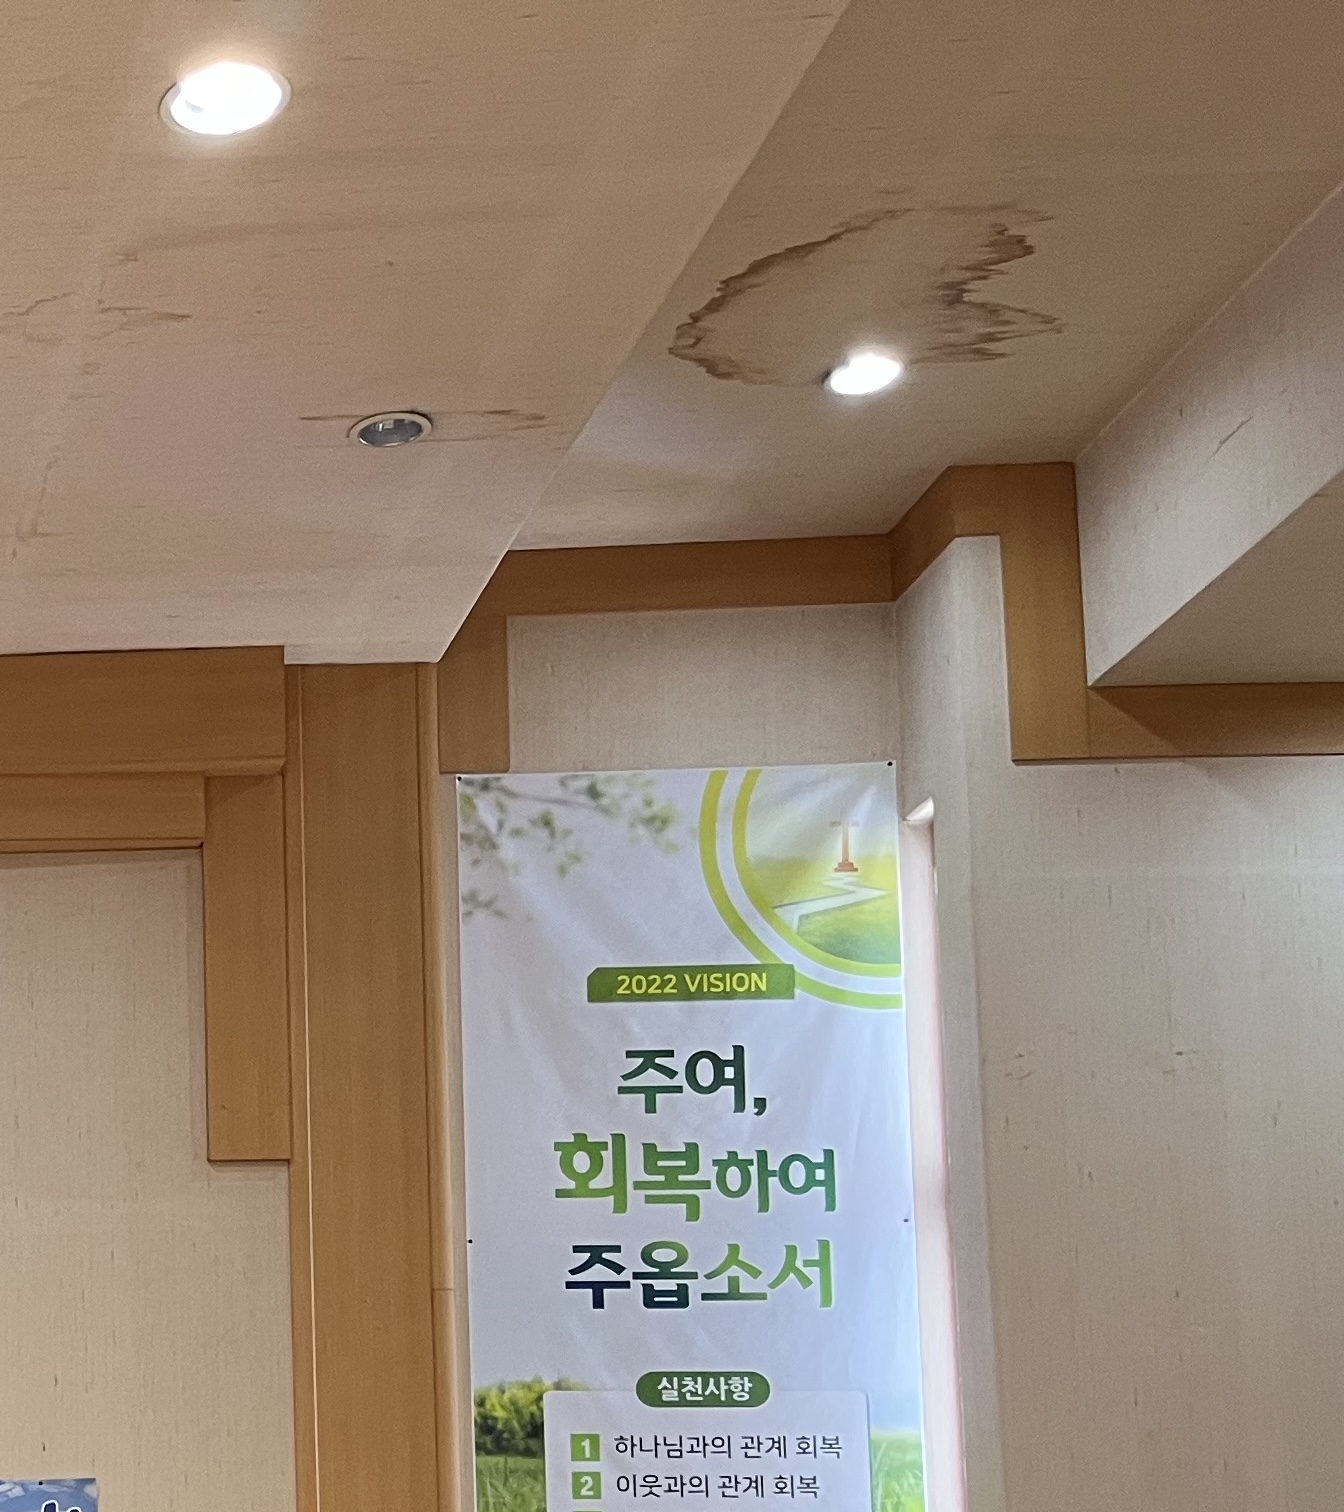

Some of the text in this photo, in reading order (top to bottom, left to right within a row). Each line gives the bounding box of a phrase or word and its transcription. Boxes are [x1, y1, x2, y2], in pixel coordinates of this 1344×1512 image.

[616, 972, 767, 994] 2022 VISION
[617, 1044, 767, 1117] 주여,
[564, 1239, 834, 1310] 주옵소서
[657, 1376, 753, 1402] 실천사항
[580, 1434, 843, 1460] 1 하나님과의 관계 회복
[580, 1474, 820, 1499] 2 이웃과의 관계 회복
